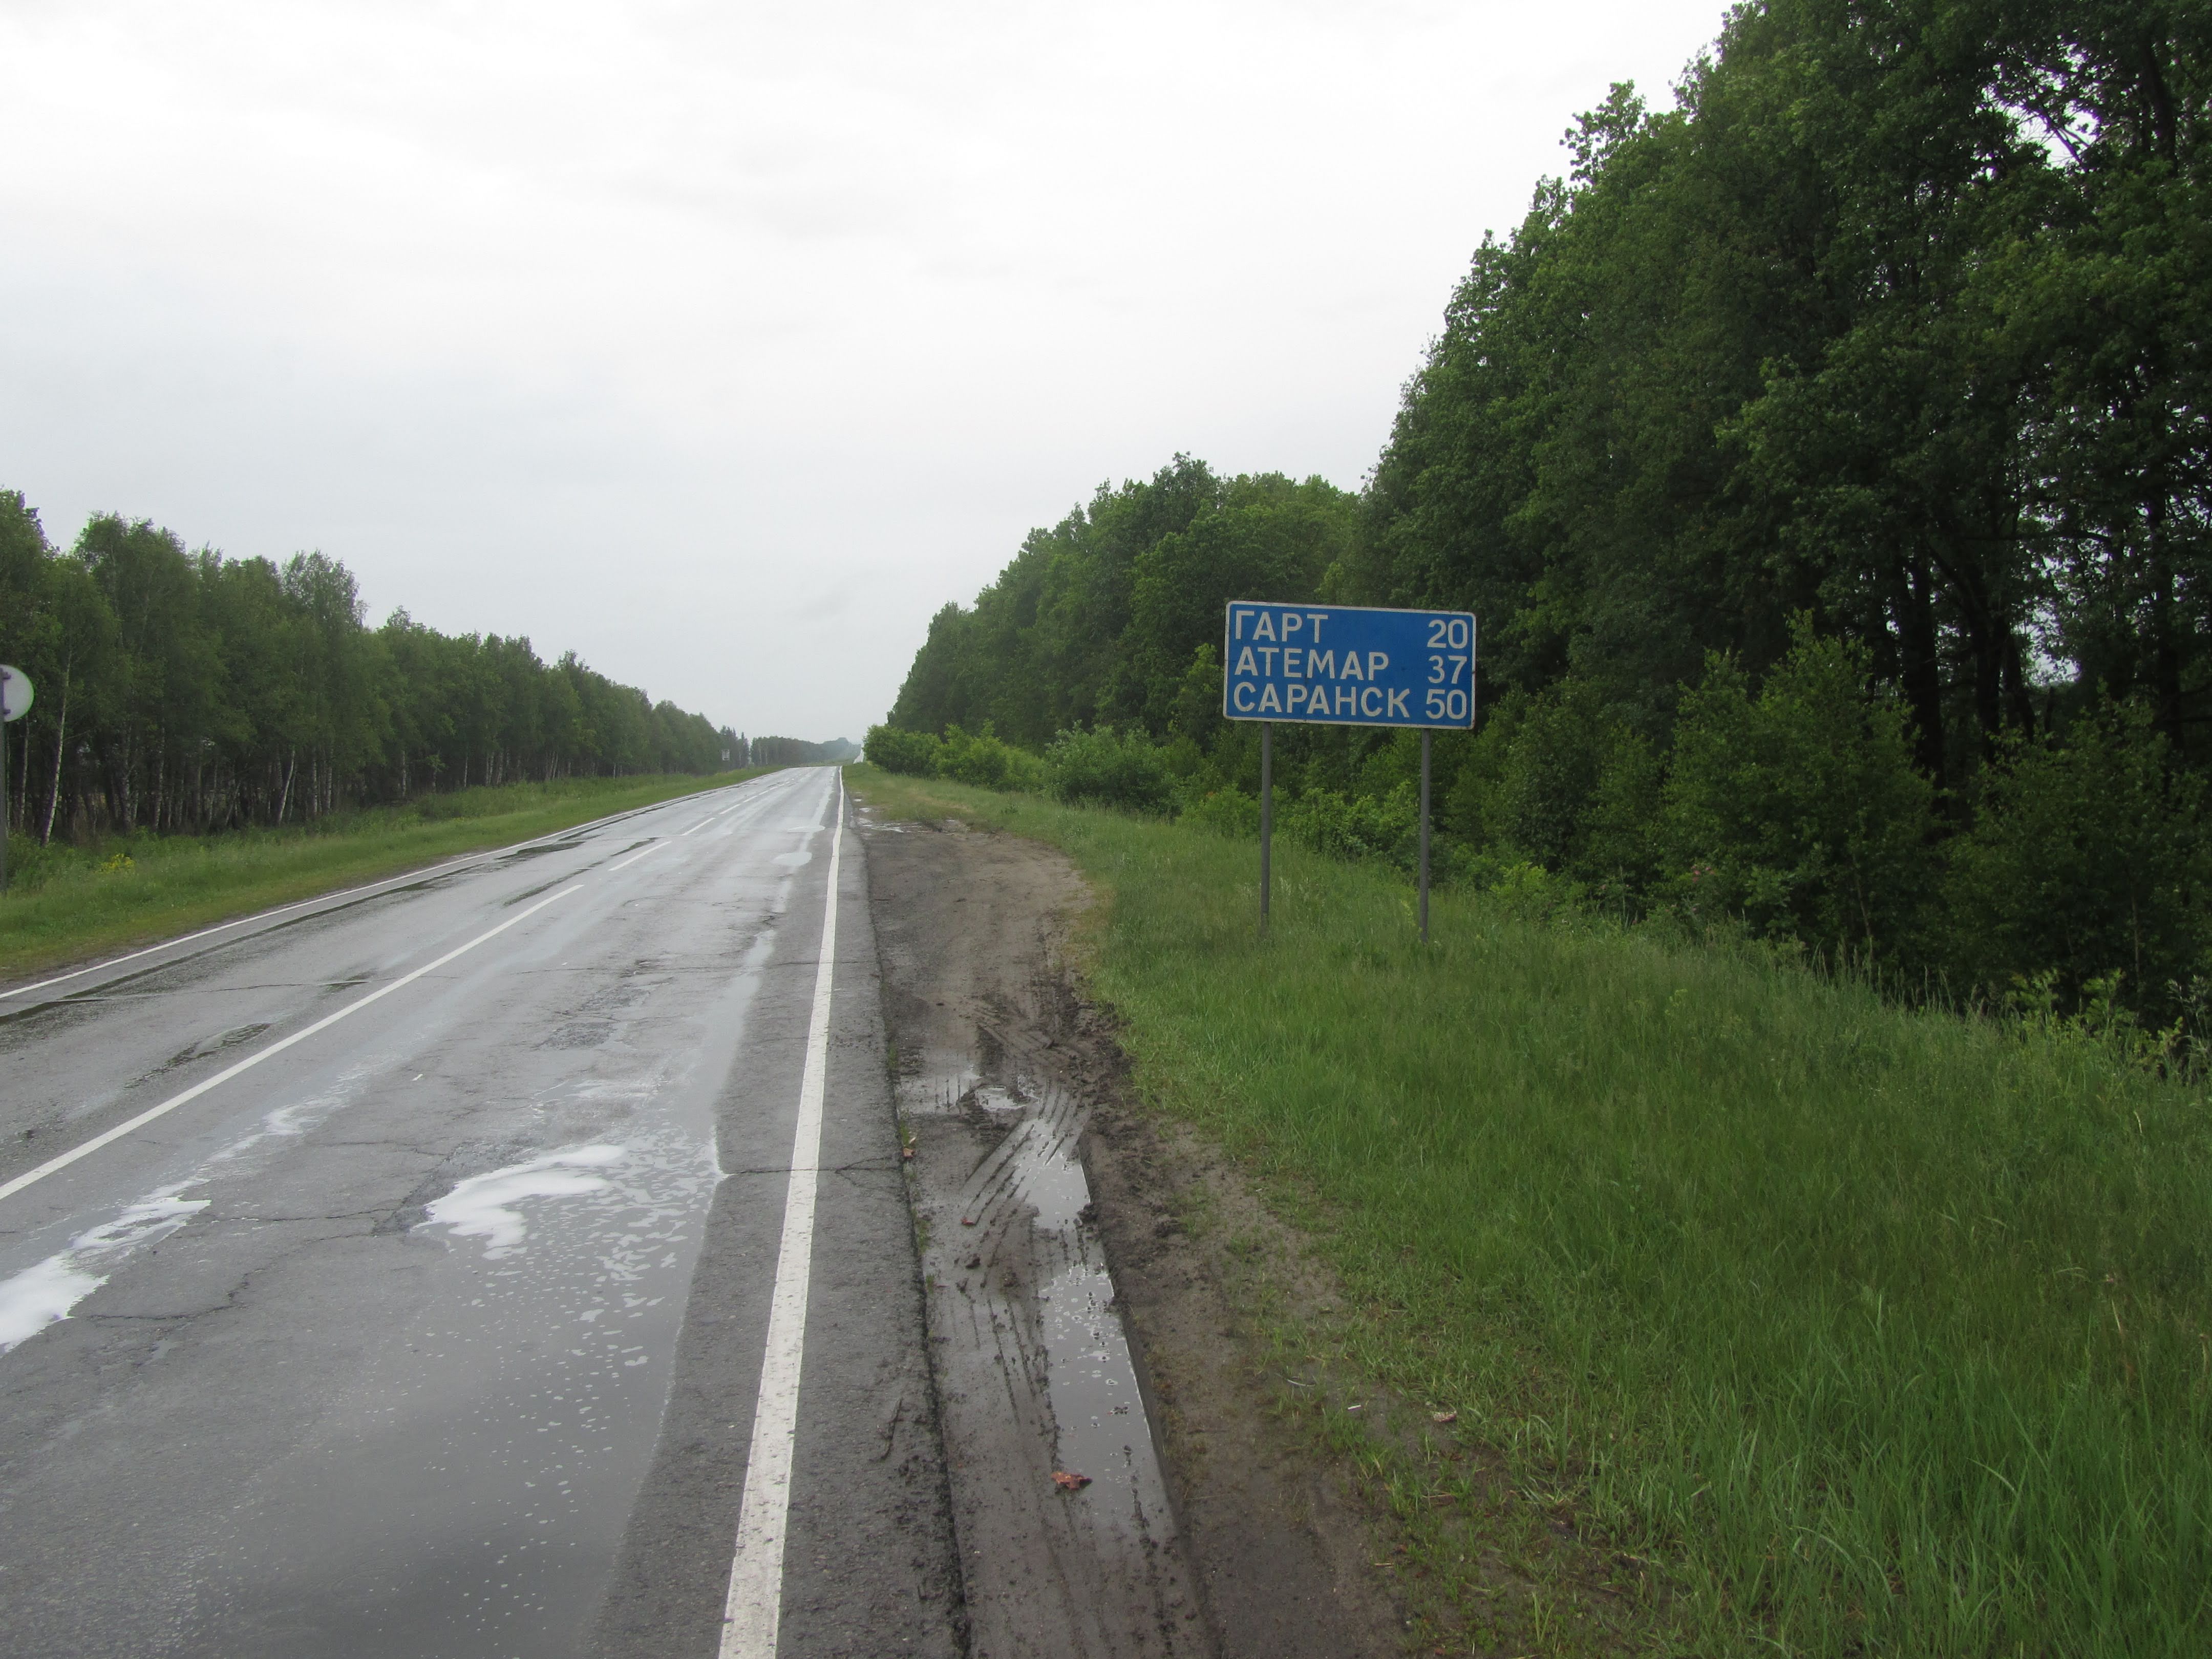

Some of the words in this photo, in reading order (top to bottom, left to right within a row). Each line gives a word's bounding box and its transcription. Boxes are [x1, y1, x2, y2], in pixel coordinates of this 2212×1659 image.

[1235, 610, 1328, 643] ГАРТ
[1427, 620, 1468, 649] 20
[1235, 646, 1389, 680] АТЕМАР
[1428, 655, 1467, 684] 37
[1233, 682, 1410, 717] САРАНСК
[1426, 689, 1466, 719] 50
